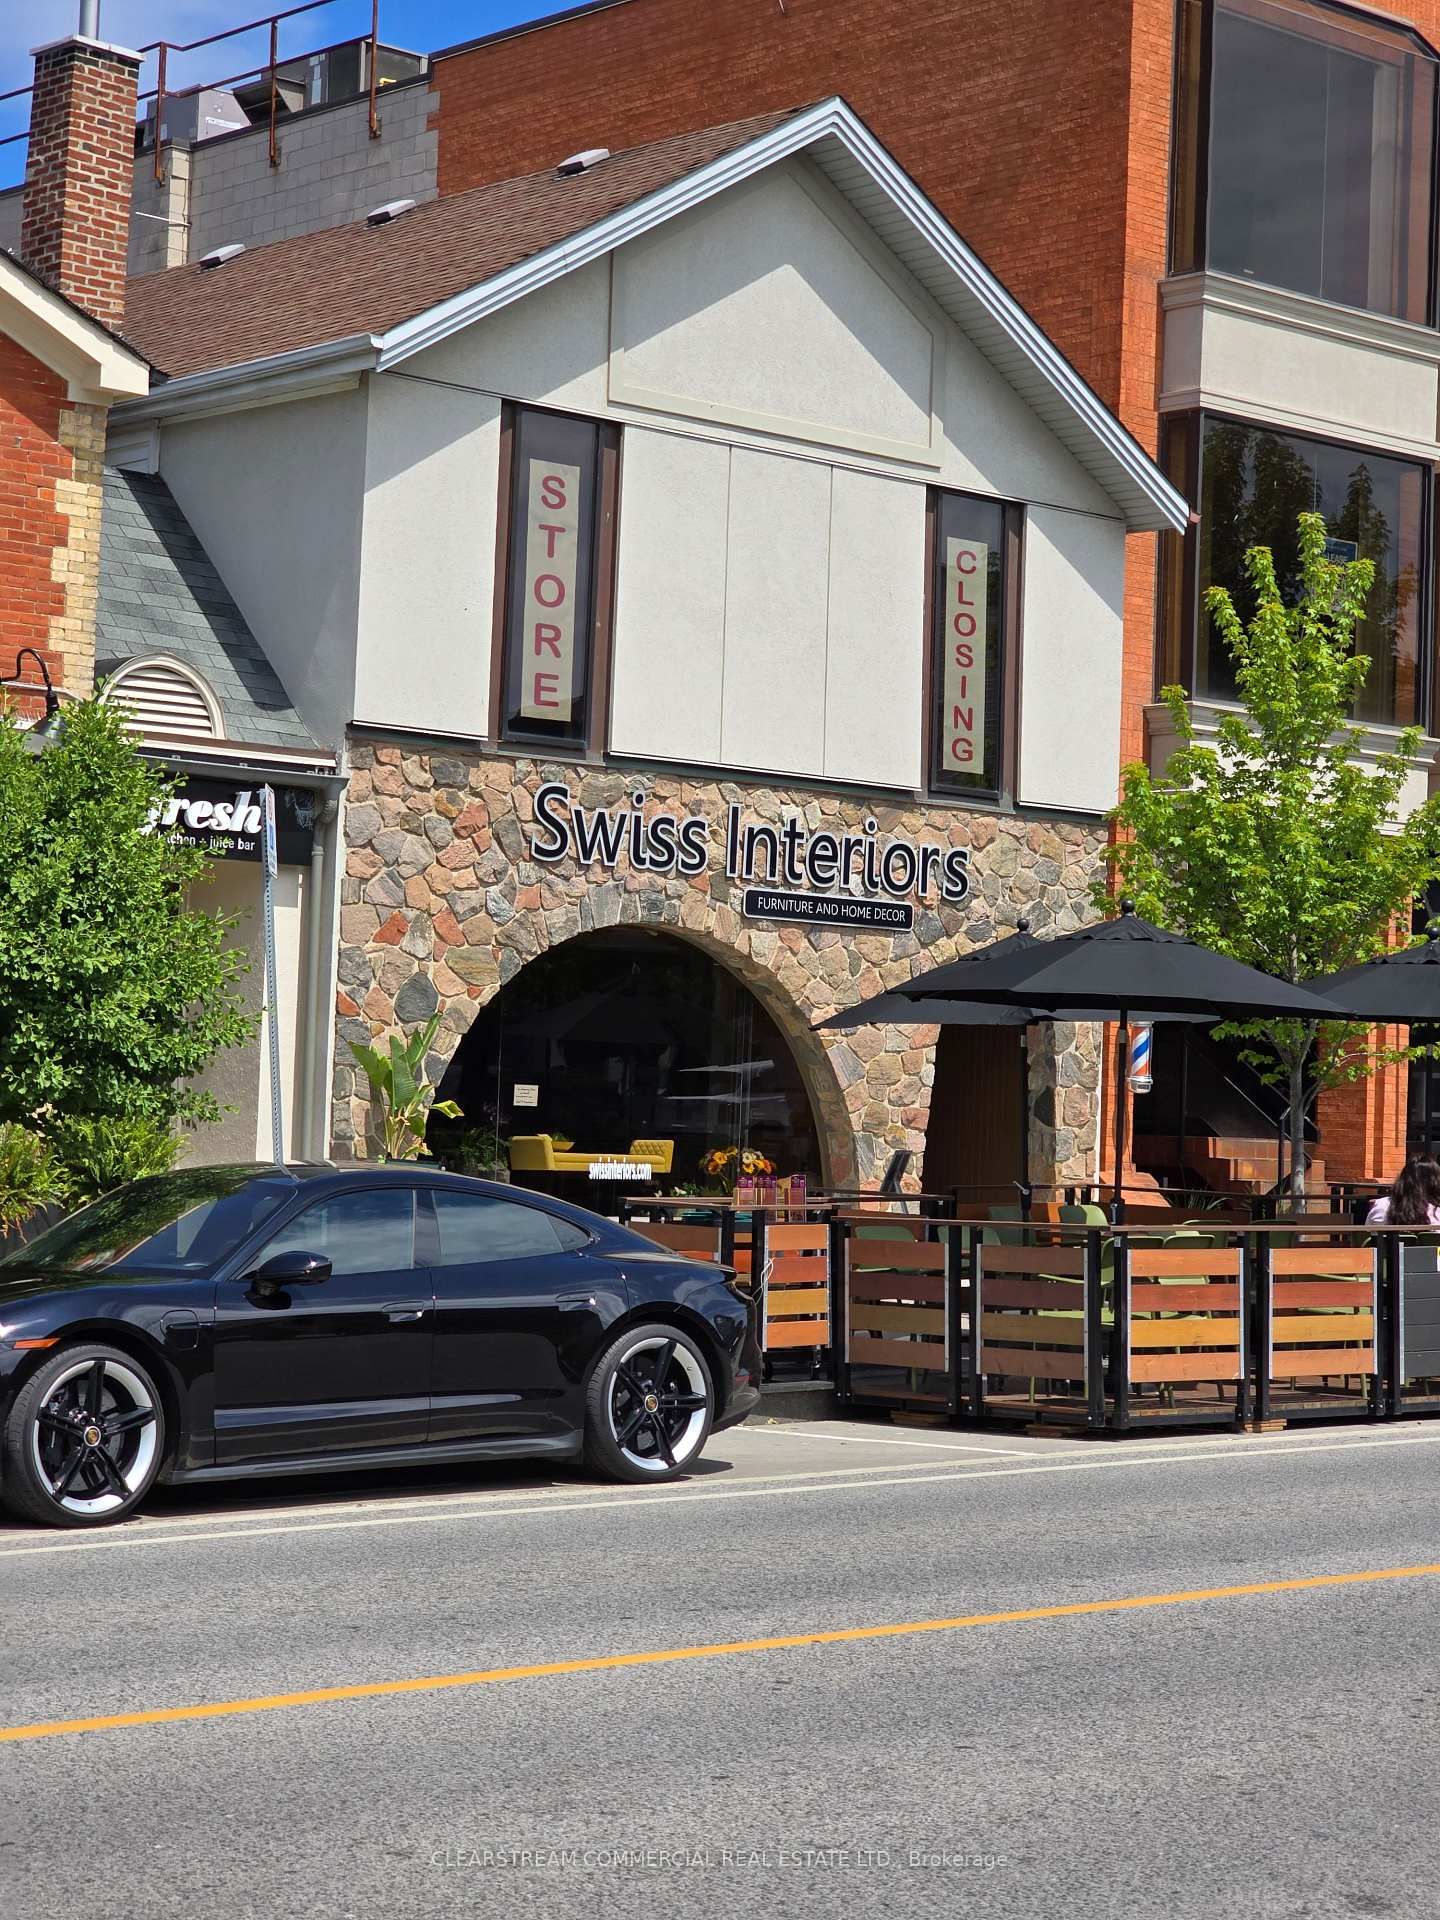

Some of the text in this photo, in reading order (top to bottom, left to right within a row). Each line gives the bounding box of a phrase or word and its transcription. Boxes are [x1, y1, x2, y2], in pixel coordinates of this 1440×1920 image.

[533, 475, 567, 709] STORE
[951, 550, 978, 763] CLOSING
[238, 838, 256, 851] bar
[530, 781, 970, 902] Swiss Interiors
[757, 896, 906, 923] FURNITURE AND HOME DECOR
[589, 1156, 652, 1180] swissinteriors.com
